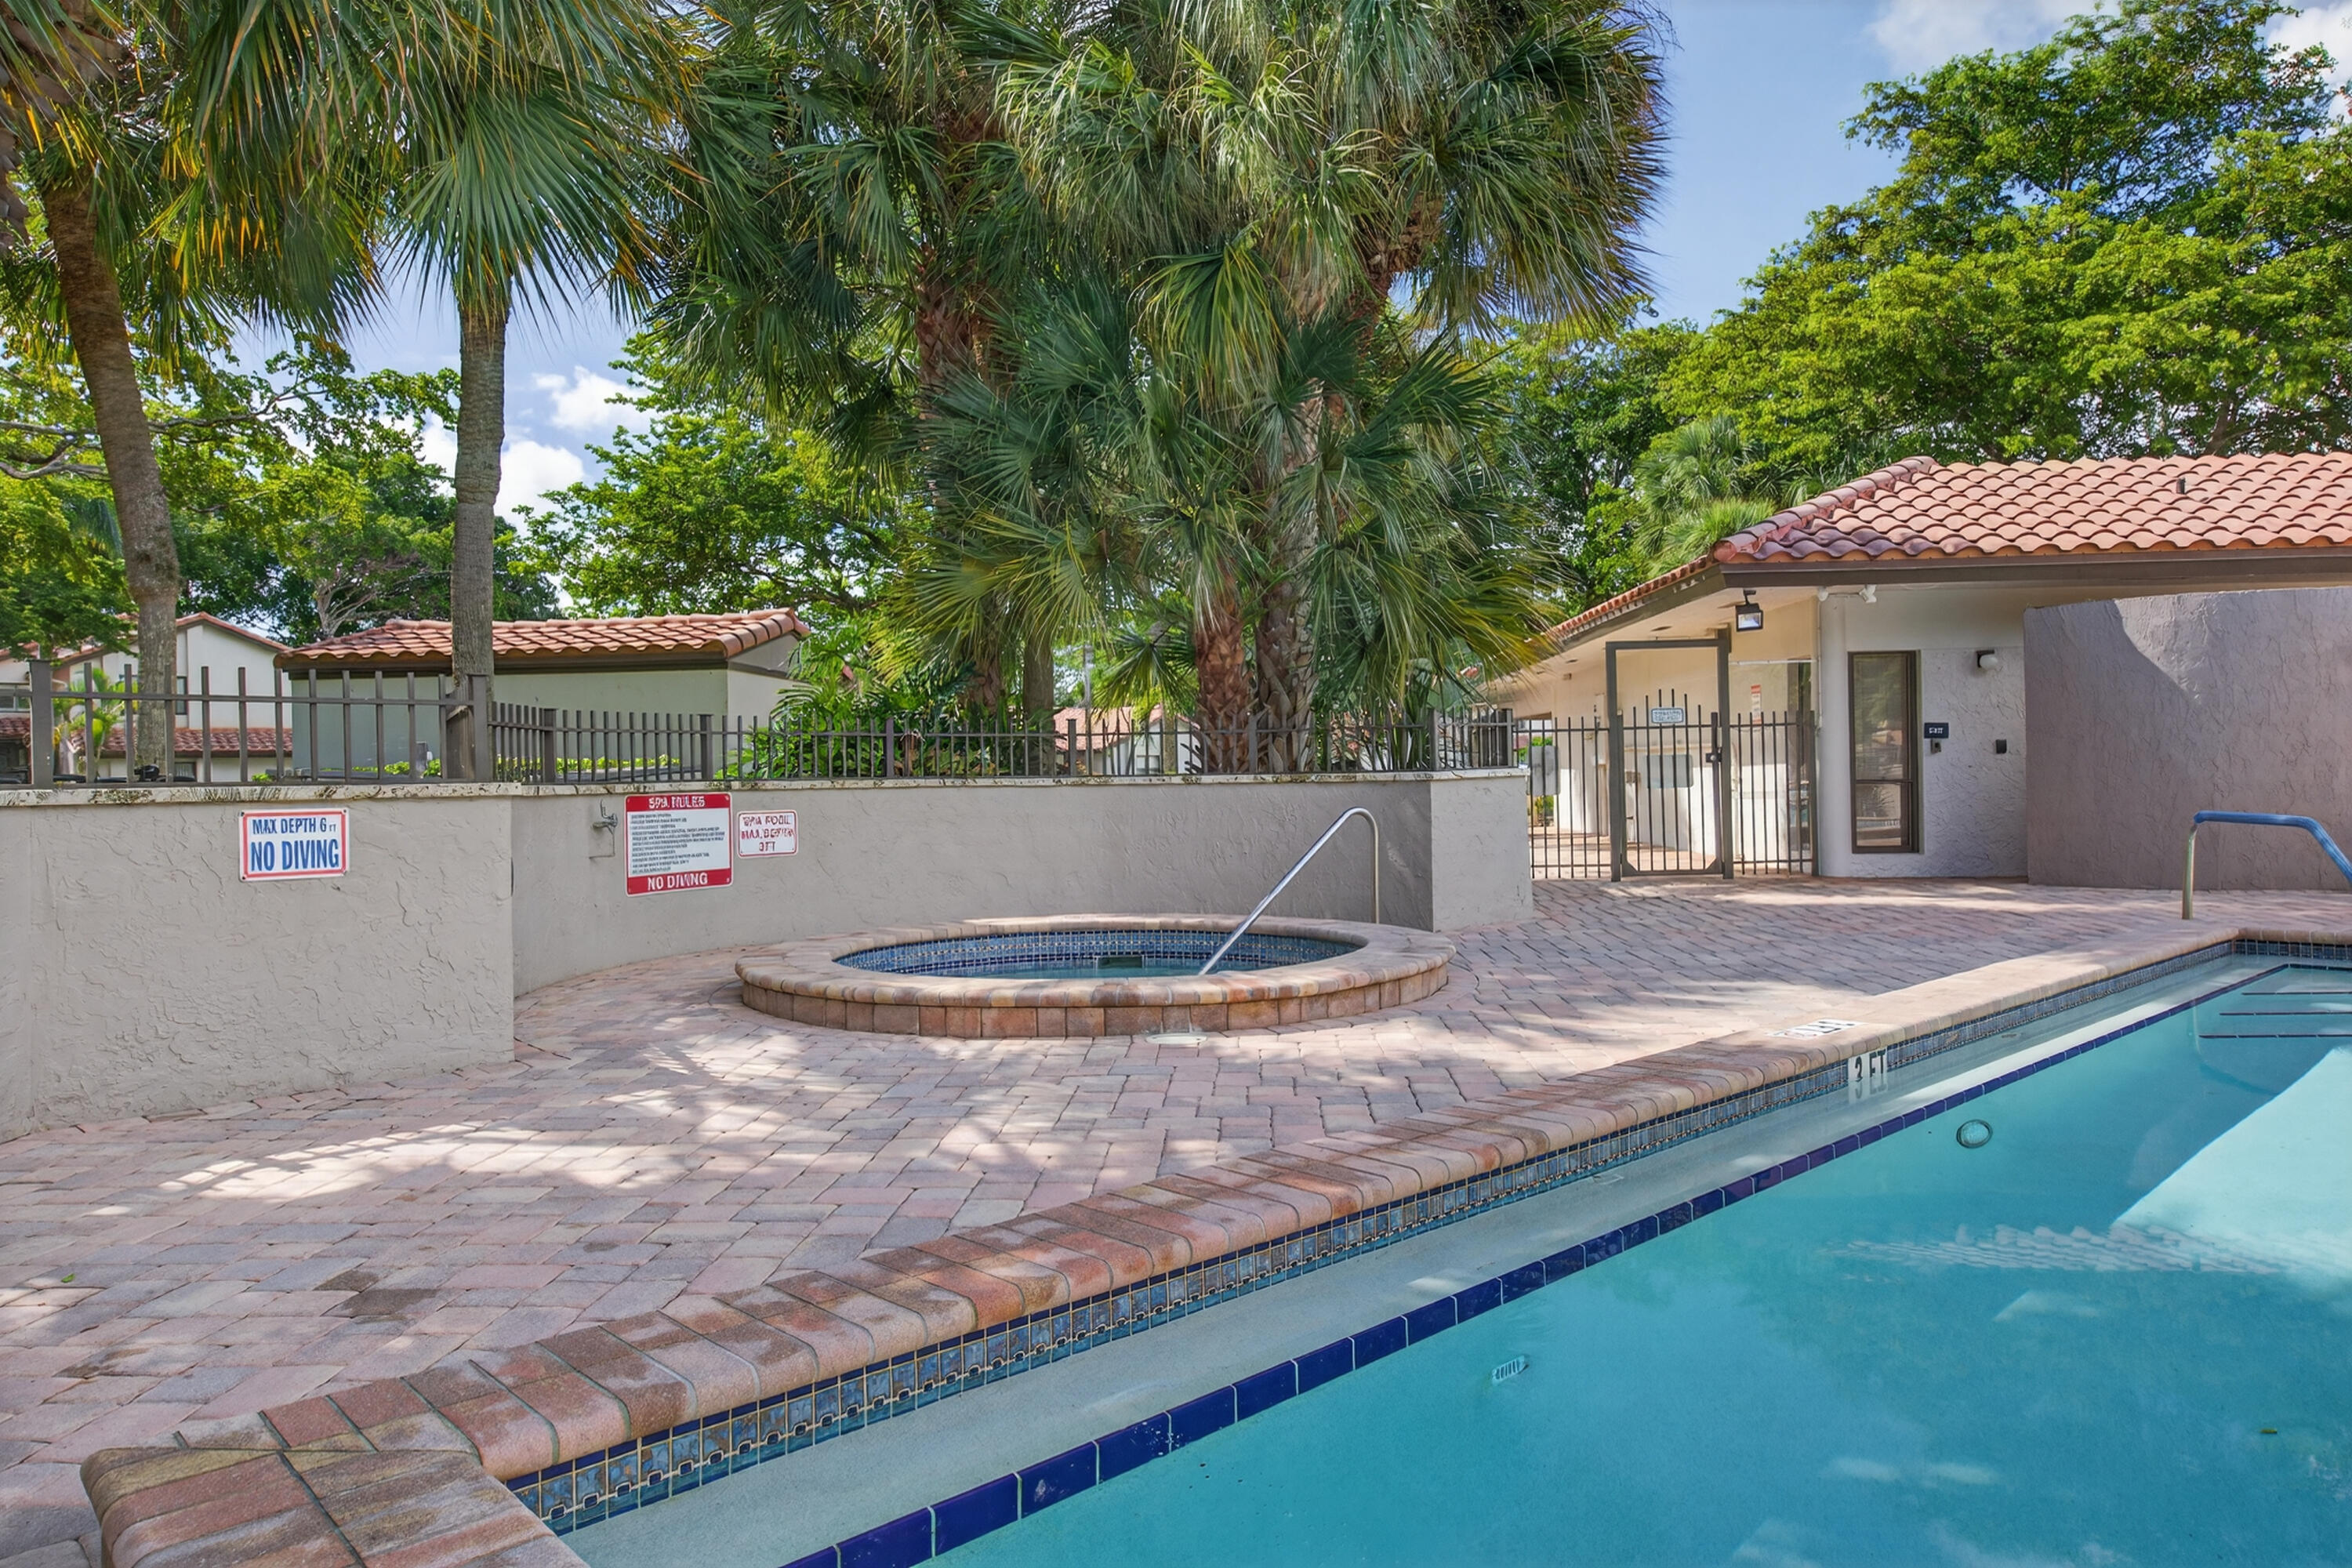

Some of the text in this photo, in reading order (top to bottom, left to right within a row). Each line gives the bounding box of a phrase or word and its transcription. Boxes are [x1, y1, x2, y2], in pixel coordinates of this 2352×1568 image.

[252, 818, 278, 834] MAX
[281, 818, 316, 833] DEPTH
[251, 838, 339, 872] NO DIVING
[648, 872, 708, 891] NO DIVING
